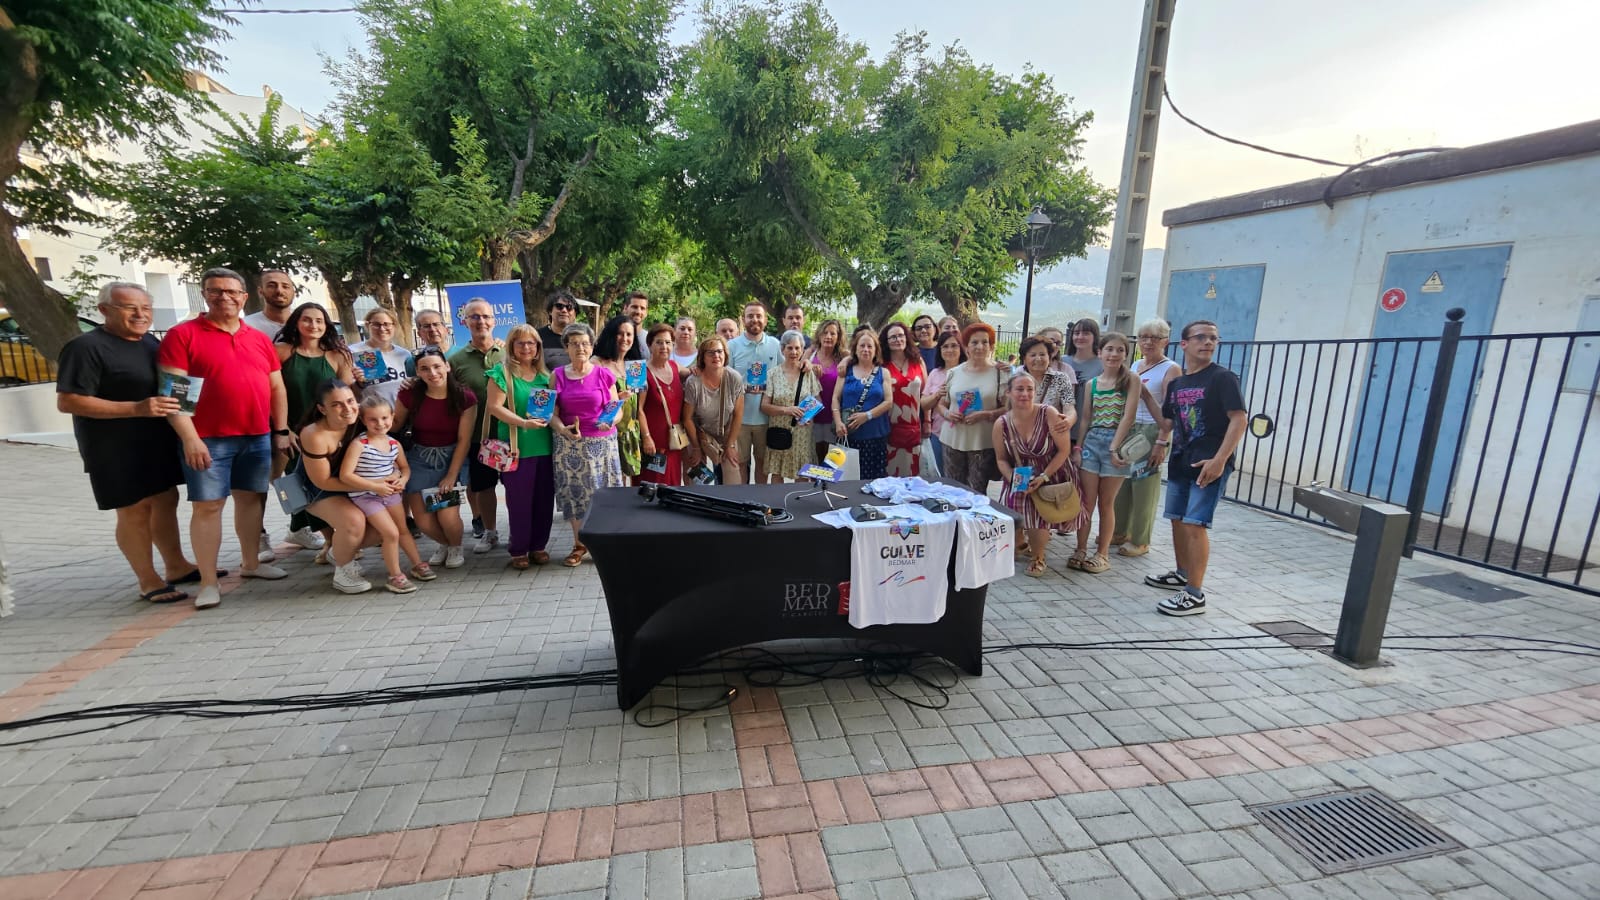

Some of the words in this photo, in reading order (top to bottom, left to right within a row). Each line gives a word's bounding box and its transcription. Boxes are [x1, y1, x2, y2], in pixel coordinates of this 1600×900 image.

[978, 524, 1007, 541] CULVE
[880, 544, 925, 560] CULVE
[784, 583, 831, 599] BED
[783, 596, 828, 611] MAR
